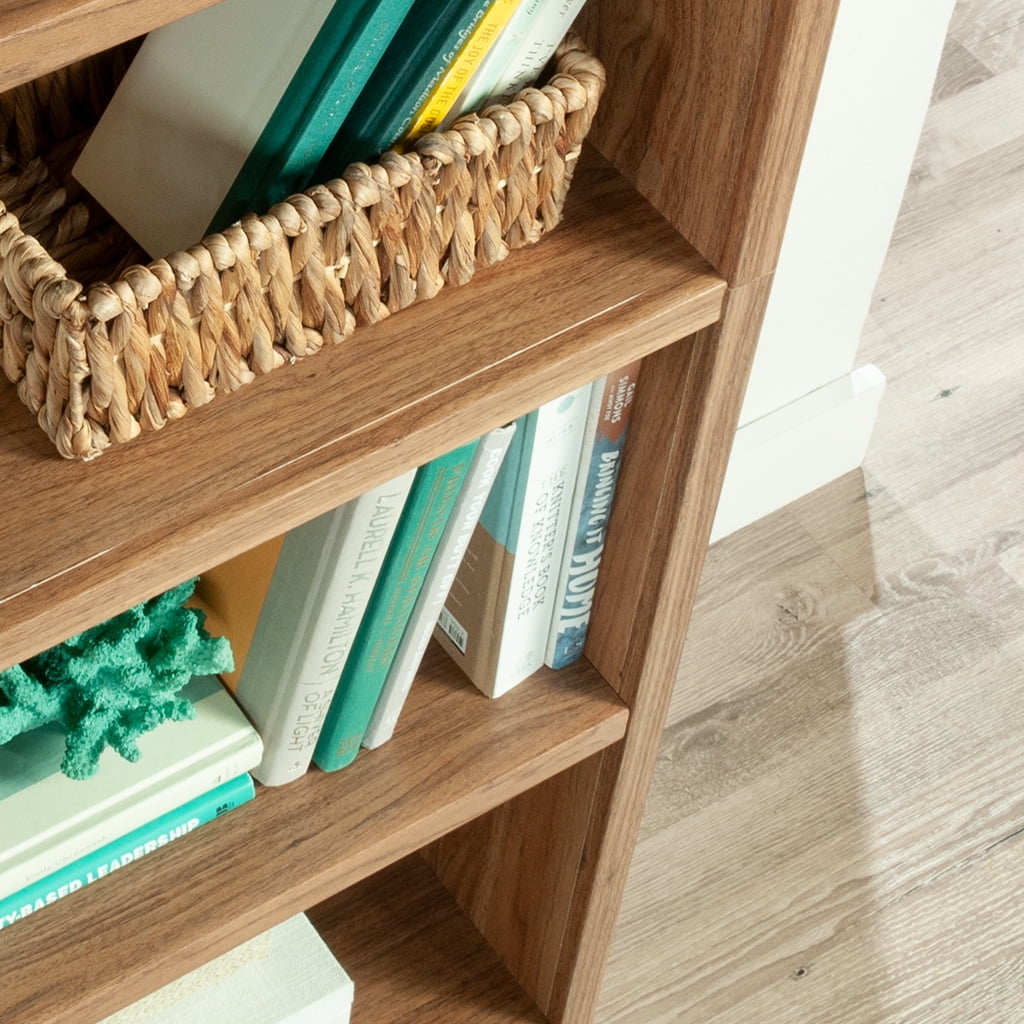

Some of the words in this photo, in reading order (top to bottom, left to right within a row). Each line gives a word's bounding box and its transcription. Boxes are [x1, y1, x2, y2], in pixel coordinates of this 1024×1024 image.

[453, 9, 484, 51] Bridges
[478, 22, 499, 43] THE
[442, 51, 455, 64] of
[465, 45, 483, 66] JOY
[506, 40, 543, 91] THINK
[409, 66, 446, 115] Madison
[437, 85, 458, 106] THE
[453, 67, 469, 86] OF
[611, 375, 629, 424] SIMMONS
[624, 383, 636, 408] GAIL
[478, 447, 502, 489] COOK
[587, 450, 619, 526] BRINGING
[463, 494, 483, 532] YOUR
[534, 491, 549, 514] OF
[540, 480, 566, 564] KNITTER'S
[356, 492, 402, 570] LAURELL
[447, 532, 471, 570] BUTT
[586, 525, 605, 545] IT
[347, 572, 370, 589] K.
[517, 517, 545, 621] KNOWLEDGE
[532, 564, 552, 612] BOOK
[557, 544, 604, 633] HOME
[320, 592, 365, 676] HAMILTON
[302, 691, 321, 711] OF
[288, 715, 314, 751] LIGHT
[86, 817, 201, 885] LEADERSHIP
